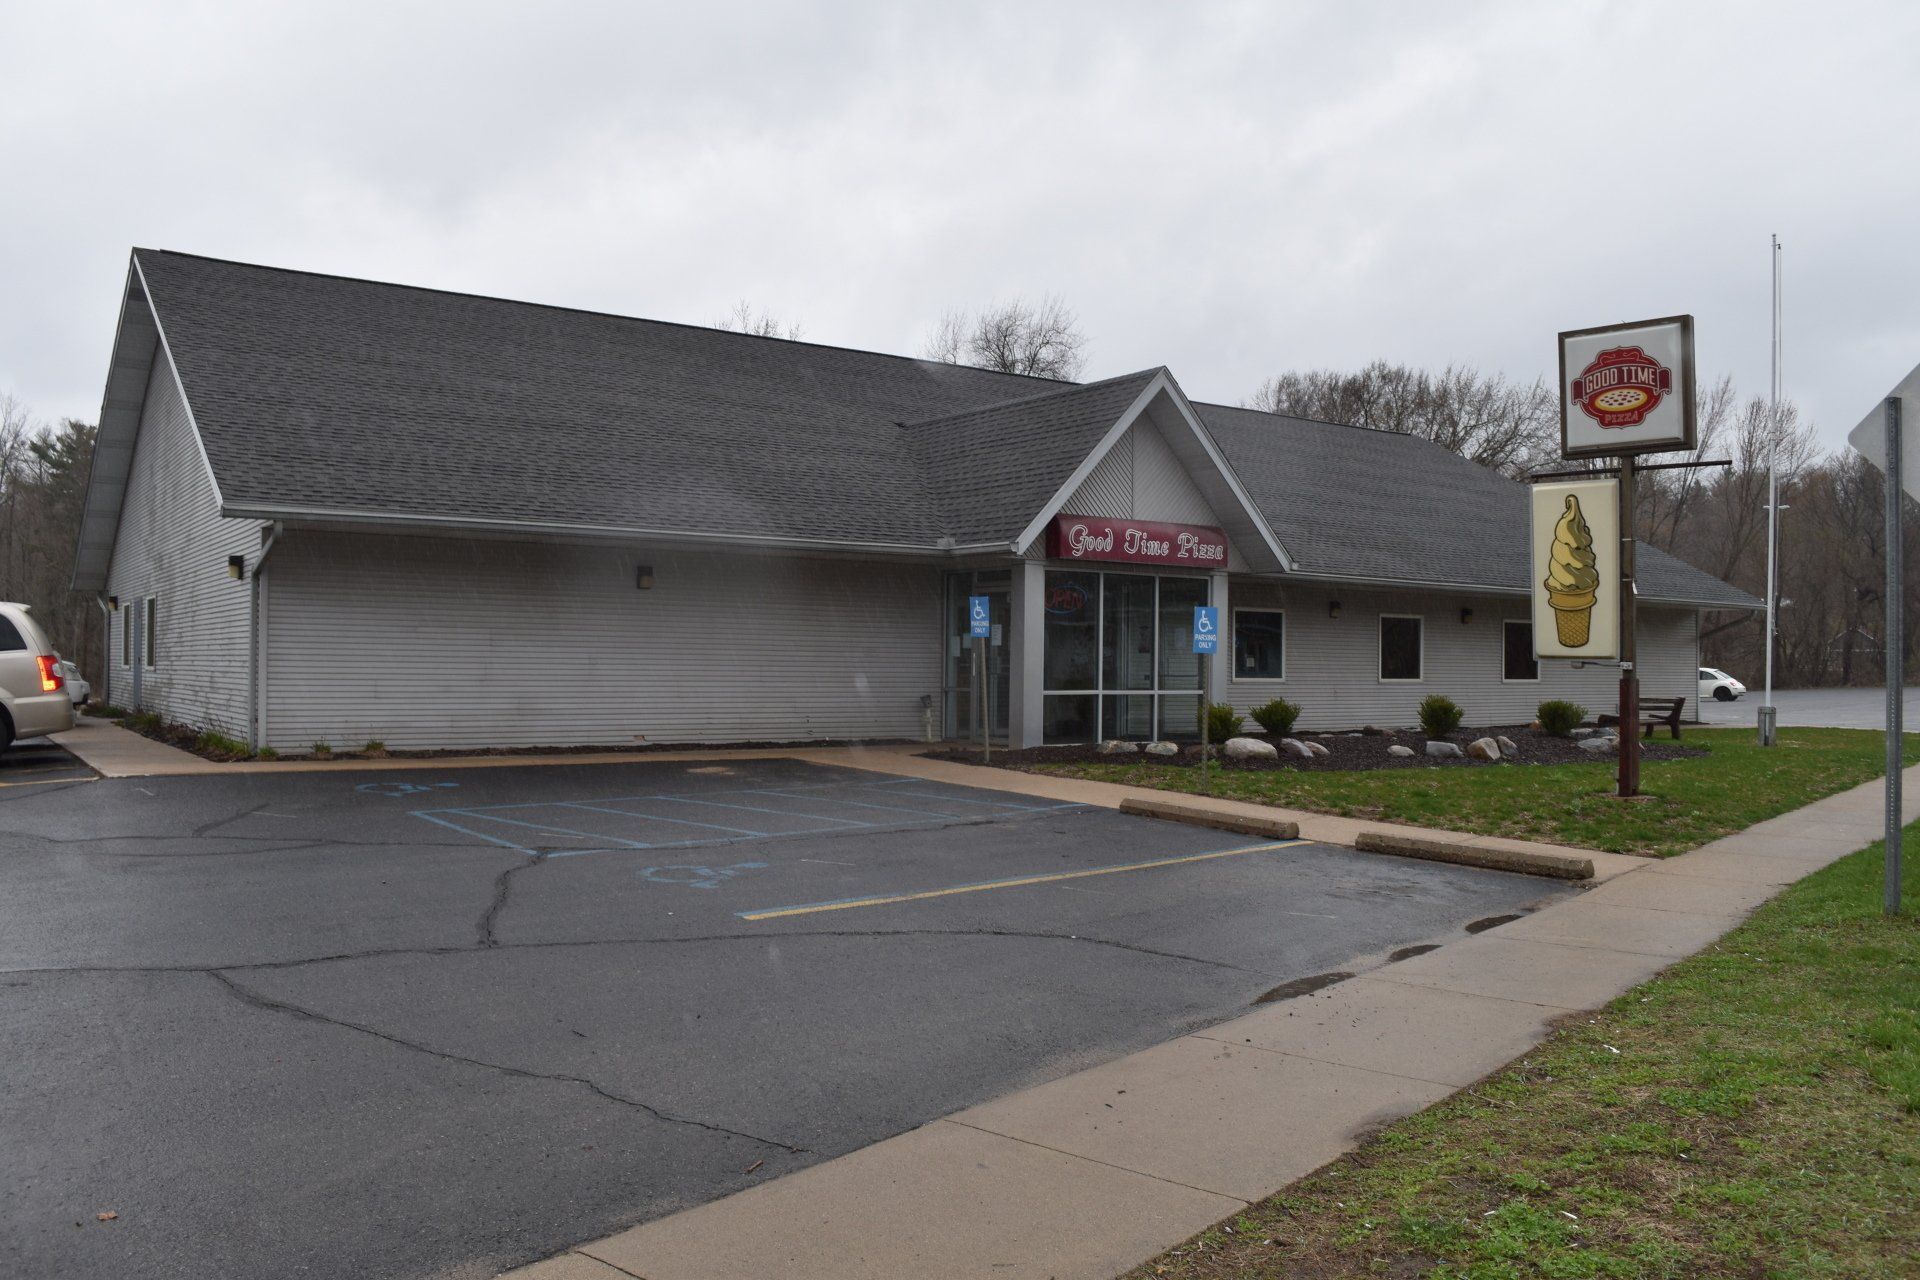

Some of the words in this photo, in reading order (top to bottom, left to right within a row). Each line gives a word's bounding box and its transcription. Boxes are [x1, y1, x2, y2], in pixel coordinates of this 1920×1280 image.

[1586, 368, 1617, 392] GOOD
[1623, 366, 1656, 386] TIME
[1604, 411, 1639, 423] PIZZA
[1069, 525, 1113, 557] Good
[1124, 529, 1169, 556] Time
[1178, 533, 1223, 560] Pizza
[1045, 588, 1084, 609] OPEN
[1195, 633, 1216, 641] PARKING
